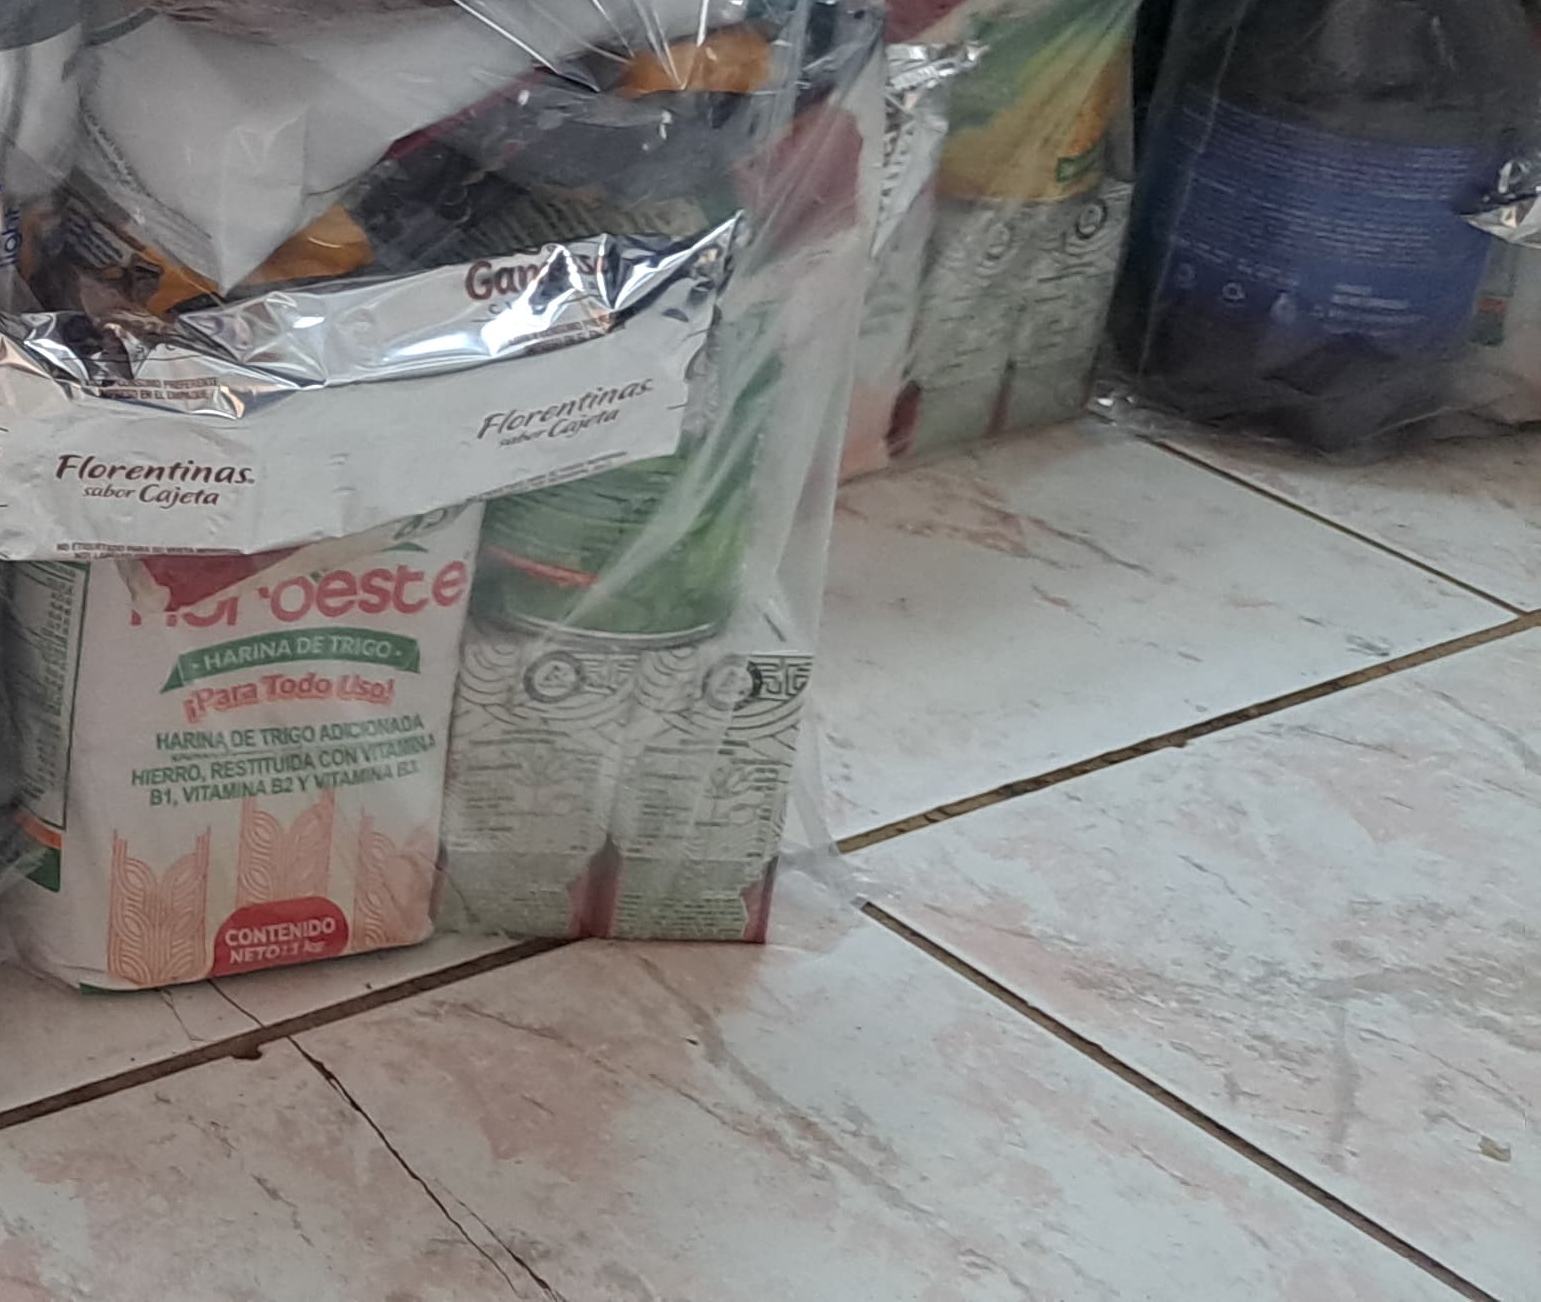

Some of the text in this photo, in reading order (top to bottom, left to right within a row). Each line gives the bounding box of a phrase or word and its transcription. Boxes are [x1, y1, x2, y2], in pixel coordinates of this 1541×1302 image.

[475, 377, 654, 441] Florentinas
[498, 408, 621, 449] sabor Cajeta
[55, 452, 251, 485] Florentinas
[82, 482, 221, 510] sabor Cajeta
[203, 636, 393, 671] HARINA DE TRIGO
[183, 671, 397, 725] ¡Para Todo Uso!
[156, 714, 425, 752] HARINA DE TRIGO ADICIONADA
[130, 765, 207, 787] HIERRO,
[210, 755, 316, 781] RESTITUIDA
[318, 748, 360, 769] CON
[149, 788, 180, 807] B1,
[182, 777, 268, 805] VITAMINA
[270, 775, 294, 795] B2
[295, 775, 309, 793] Y
[311, 765, 395, 791] VITAMINA
[223, 917, 337, 947] CONTENIDO
